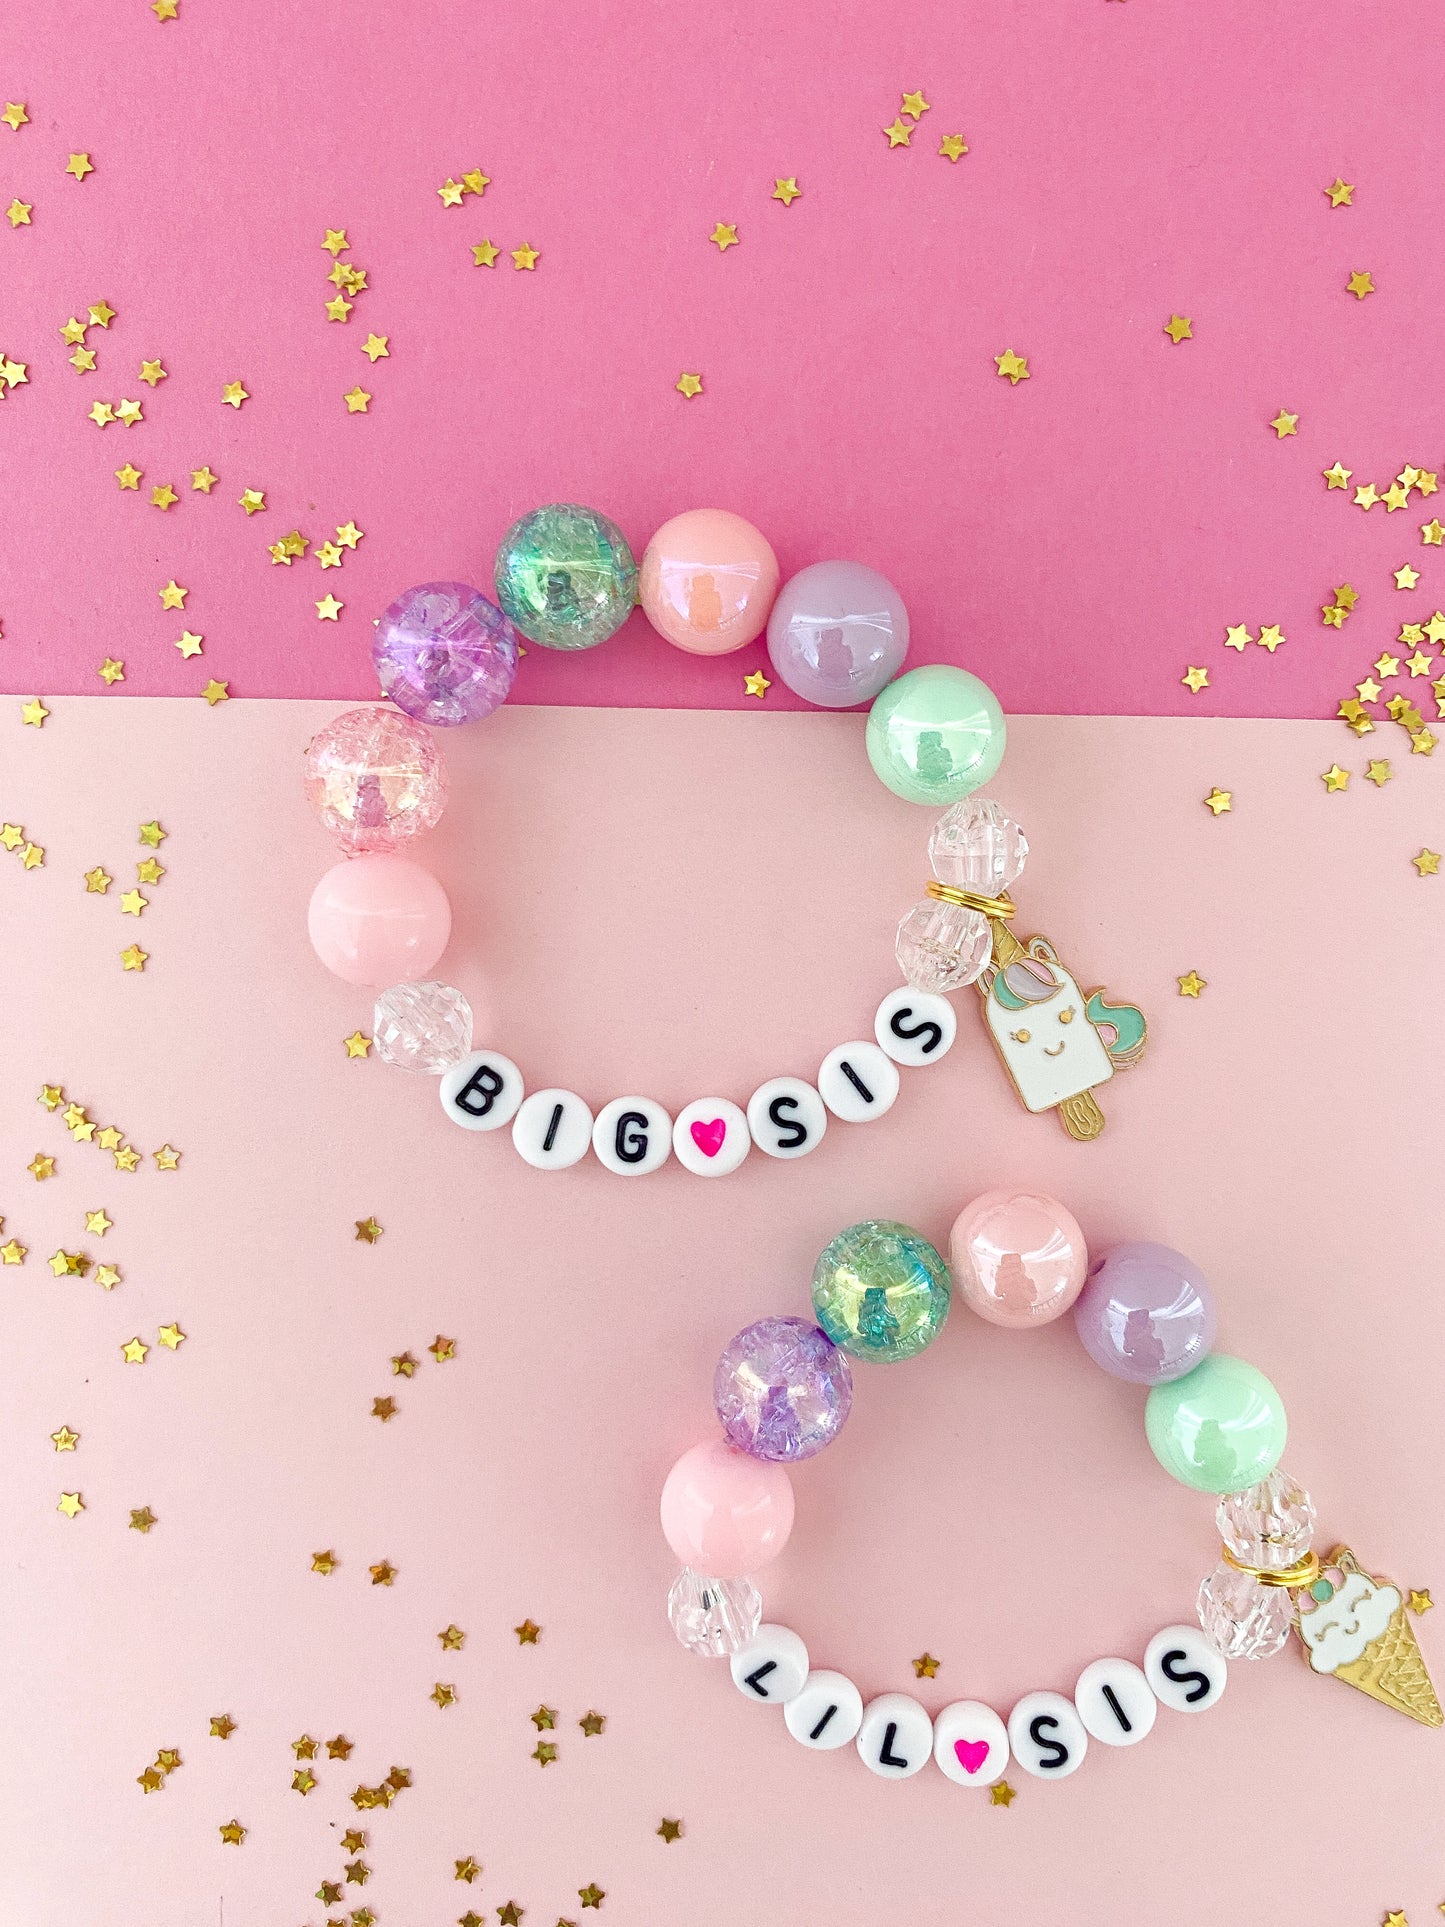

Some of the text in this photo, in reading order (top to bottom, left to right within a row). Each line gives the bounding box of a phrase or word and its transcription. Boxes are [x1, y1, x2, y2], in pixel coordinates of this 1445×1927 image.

[455, 1007, 943, 1164] BIG SIS
[744, 1649, 1211, 1769] LIL SIS
